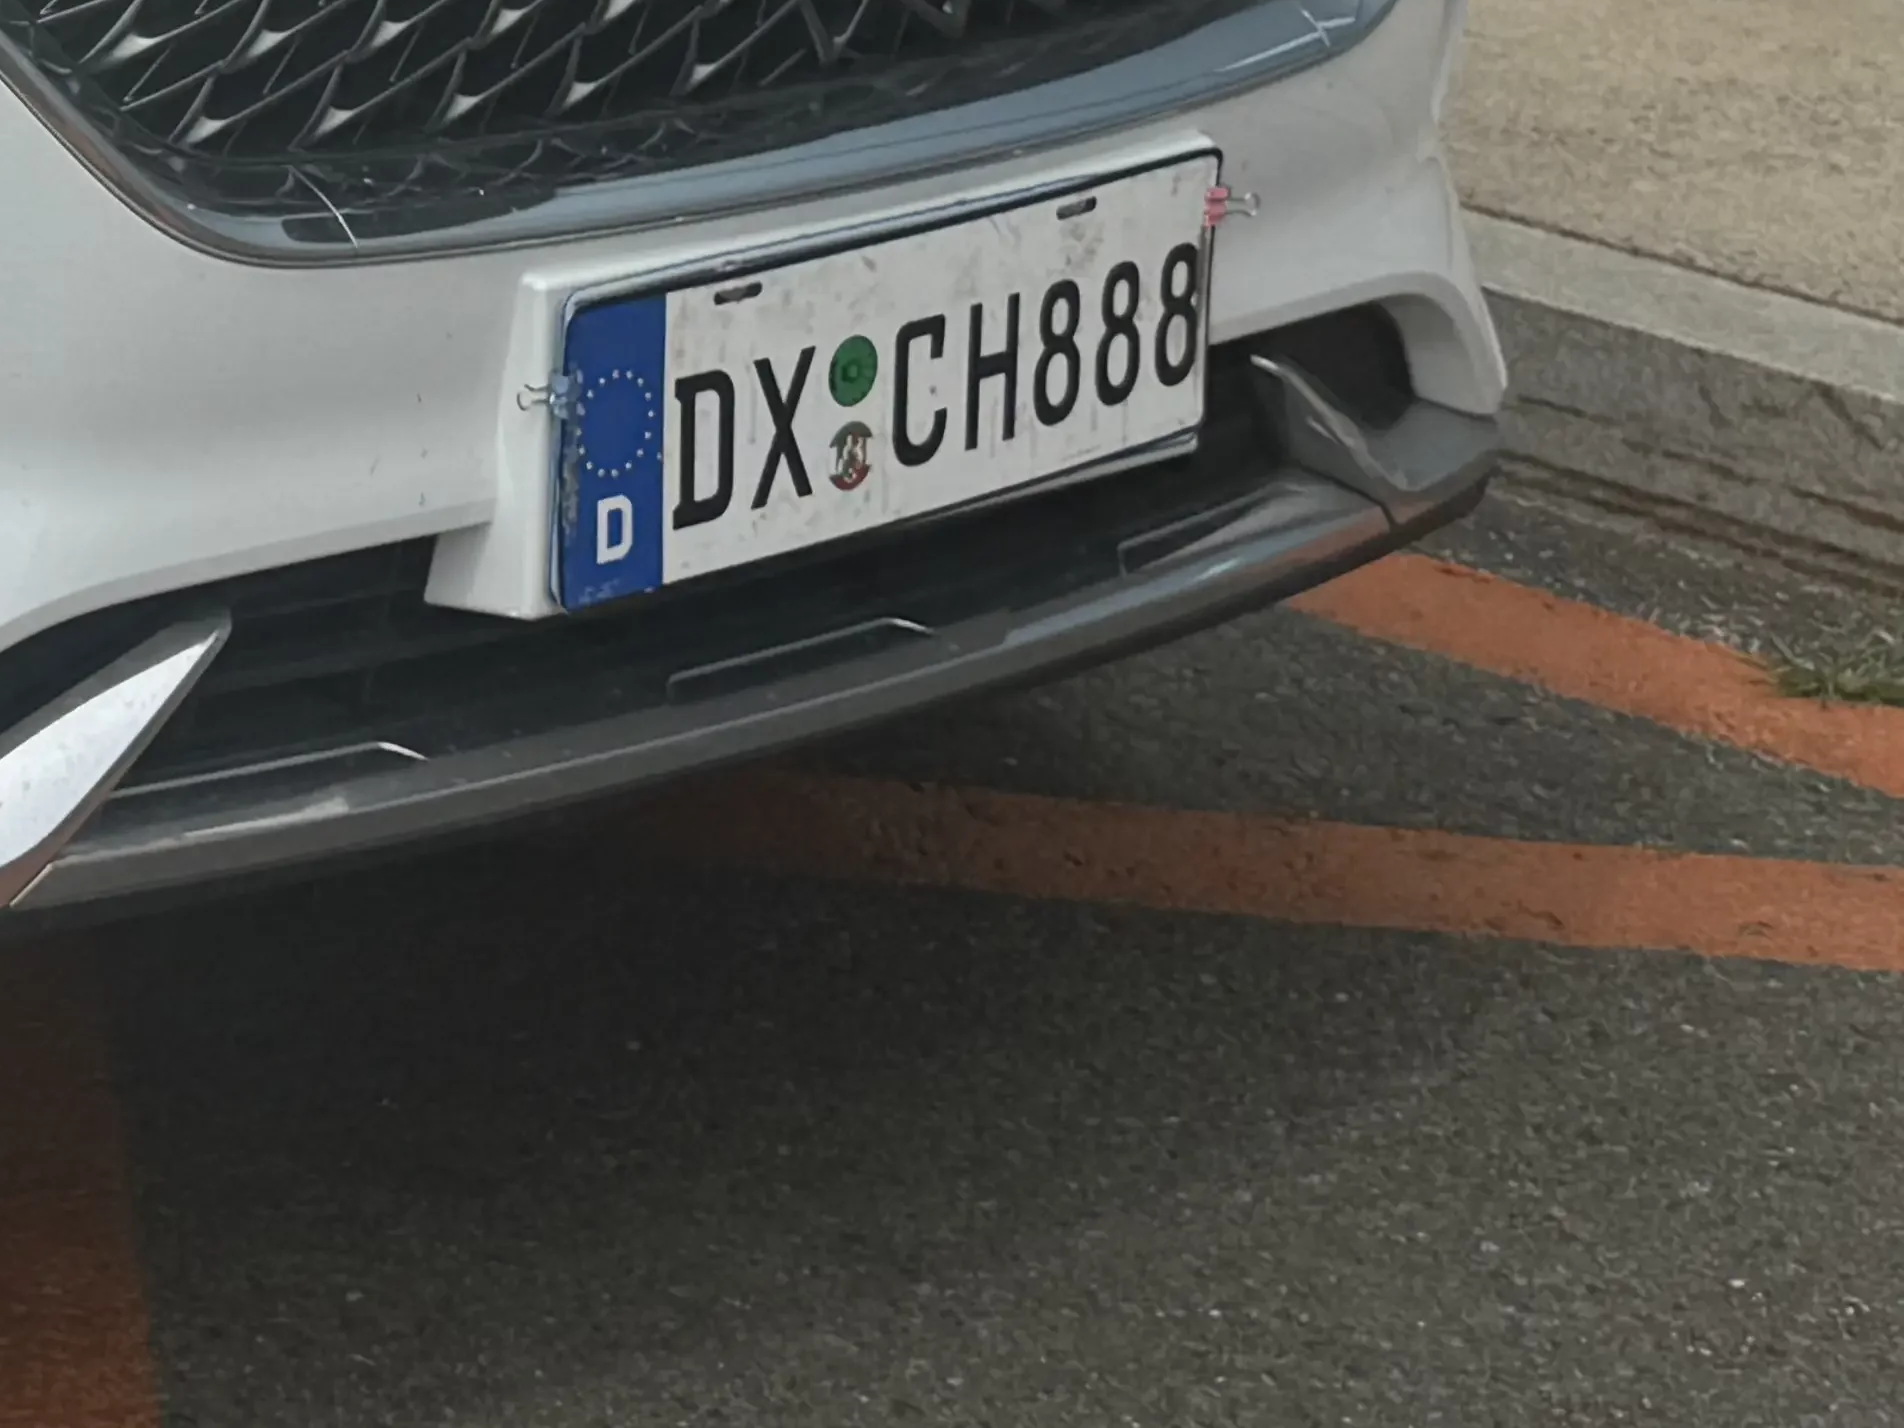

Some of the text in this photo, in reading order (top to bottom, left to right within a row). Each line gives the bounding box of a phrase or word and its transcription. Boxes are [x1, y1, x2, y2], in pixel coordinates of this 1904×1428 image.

[672, 242, 1201, 531] DX CH888
[596, 494, 634, 565] D
